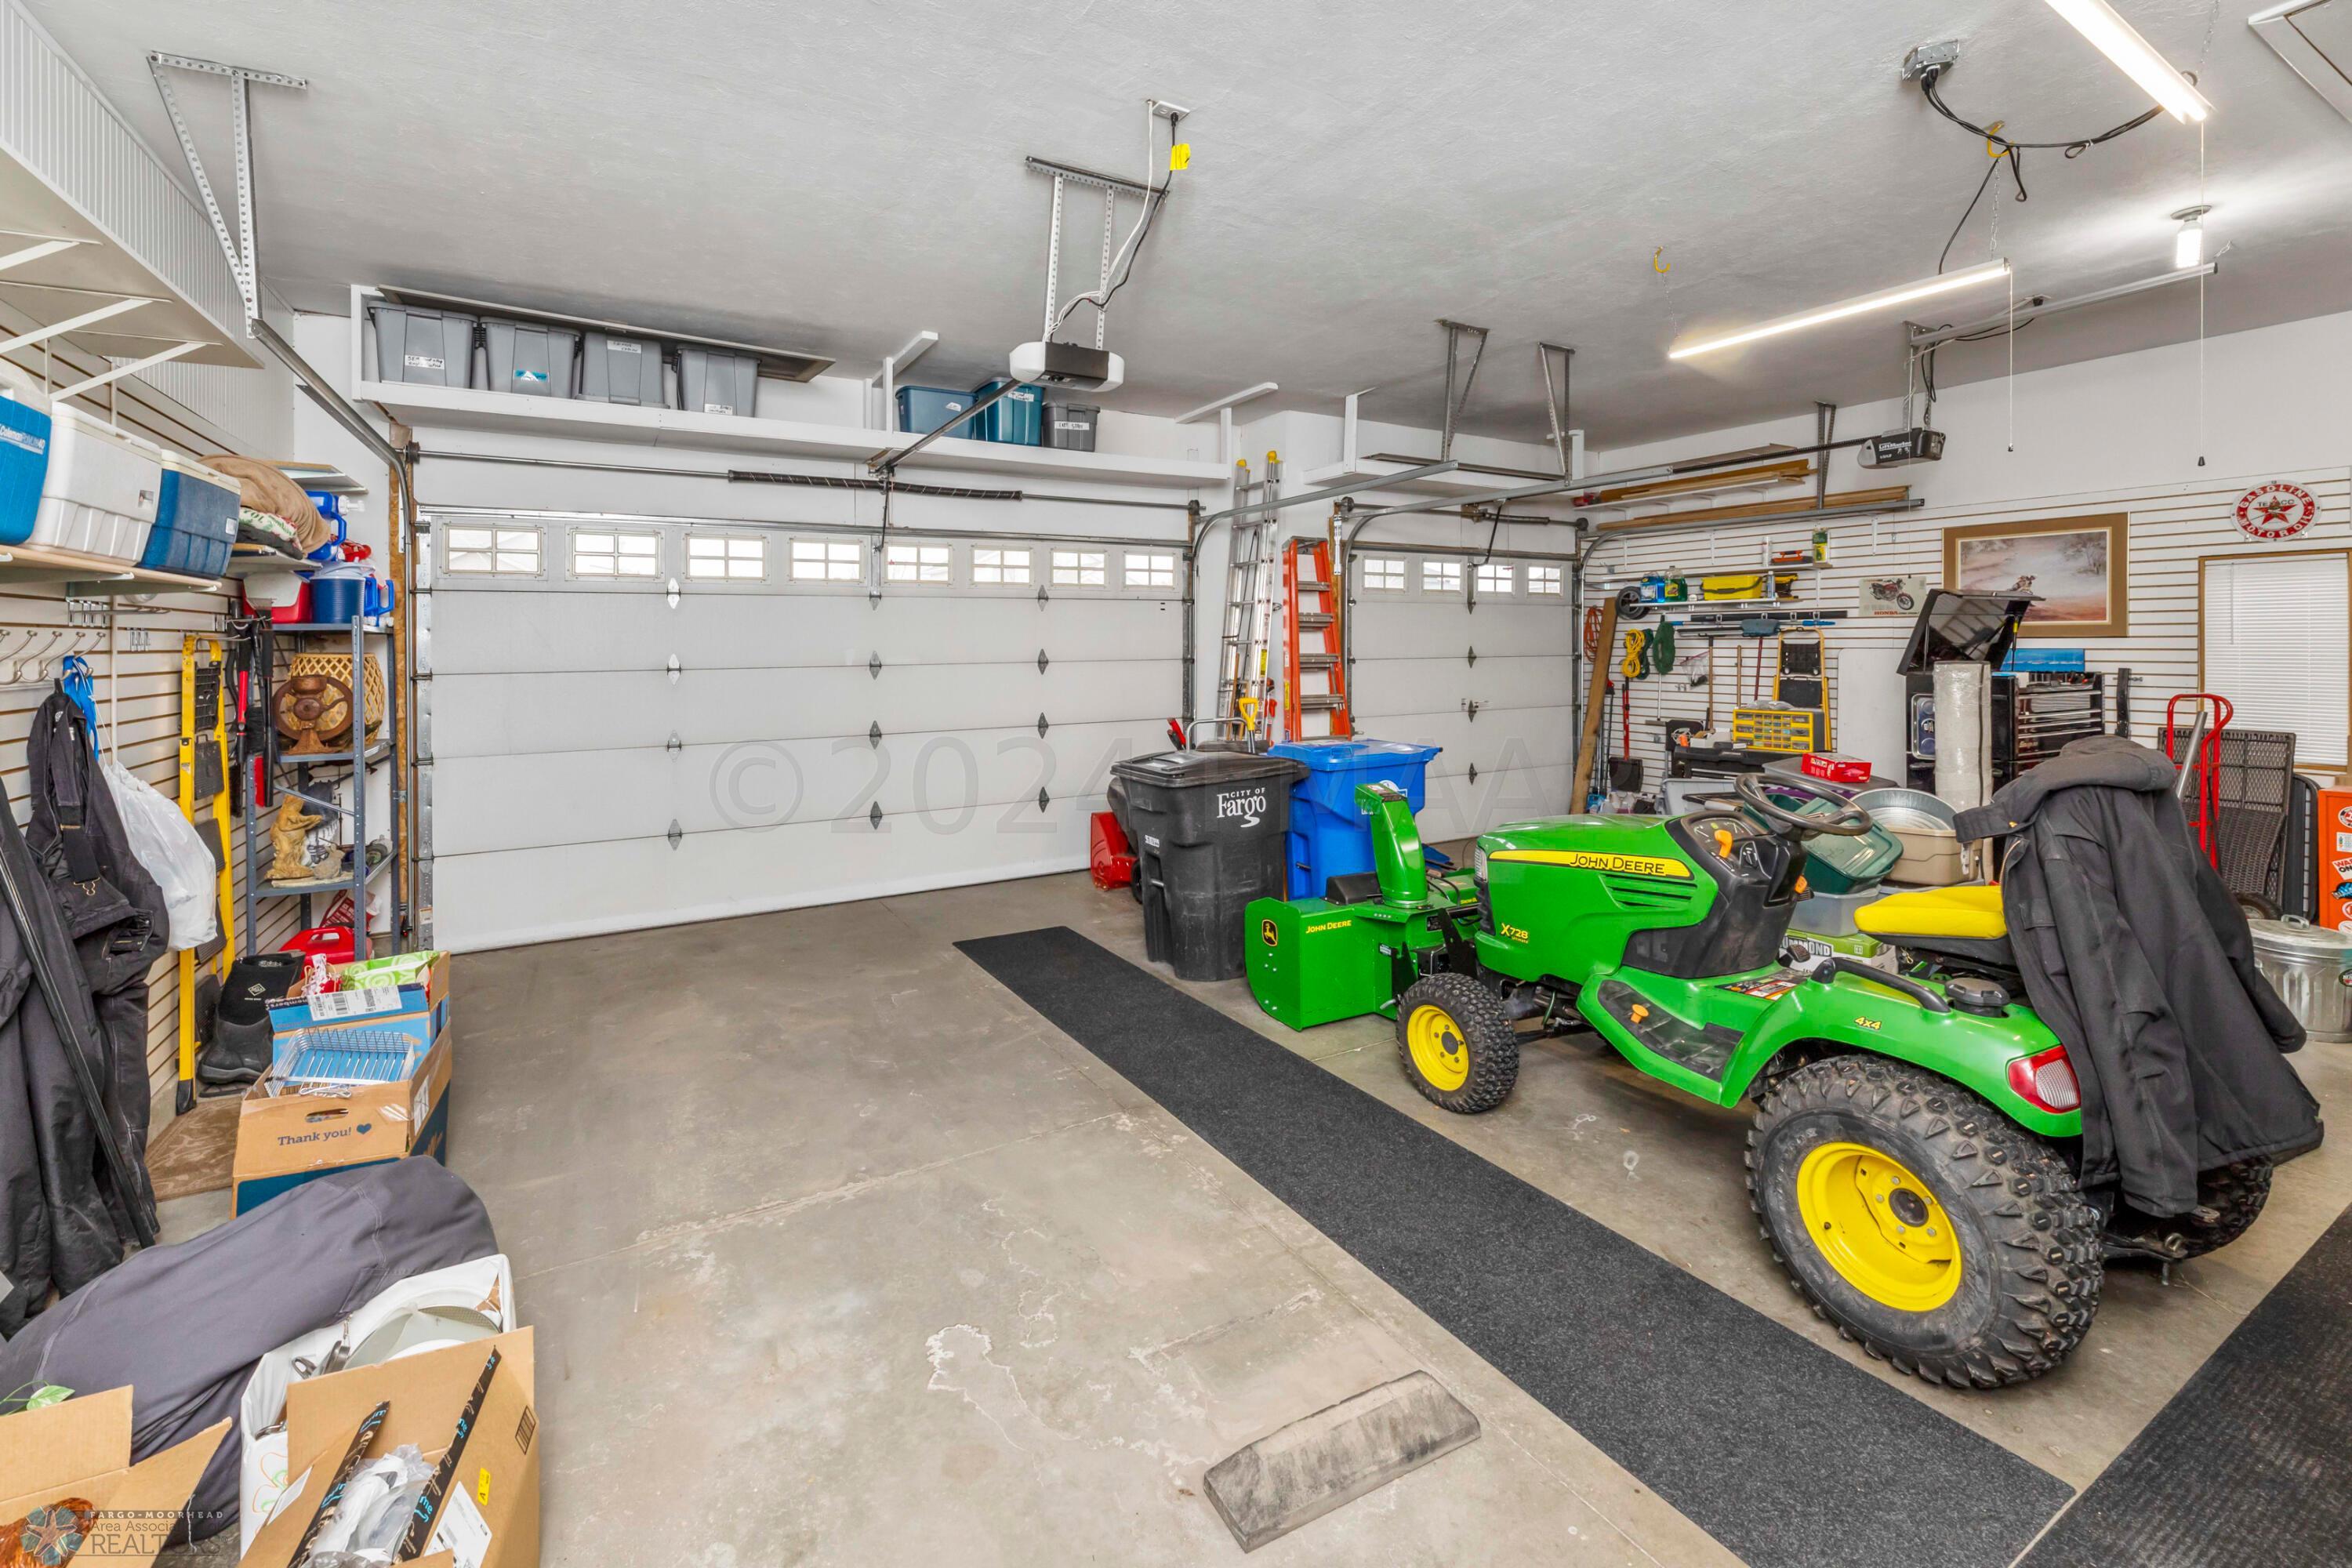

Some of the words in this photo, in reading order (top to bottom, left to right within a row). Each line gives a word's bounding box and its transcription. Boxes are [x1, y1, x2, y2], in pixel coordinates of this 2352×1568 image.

[2239, 485, 2314, 509] GASOLINE
[2237, 514, 2289, 538] MOTOR
[1230, 789, 1251, 798] CITY
[1216, 793, 1267, 828] Fargo
[1570, 853, 1609, 869] JOHN
[1612, 857, 1665, 874] DEERE
[1305, 925, 1326, 934] JOHN
[1327, 920, 1352, 930] DEERE
[1501, 923, 1529, 939] X728
[1853, 1016, 1882, 1031] 4x4
[278, 1131, 321, 1146] Thank
[323, 1127, 352, 1142] you!
